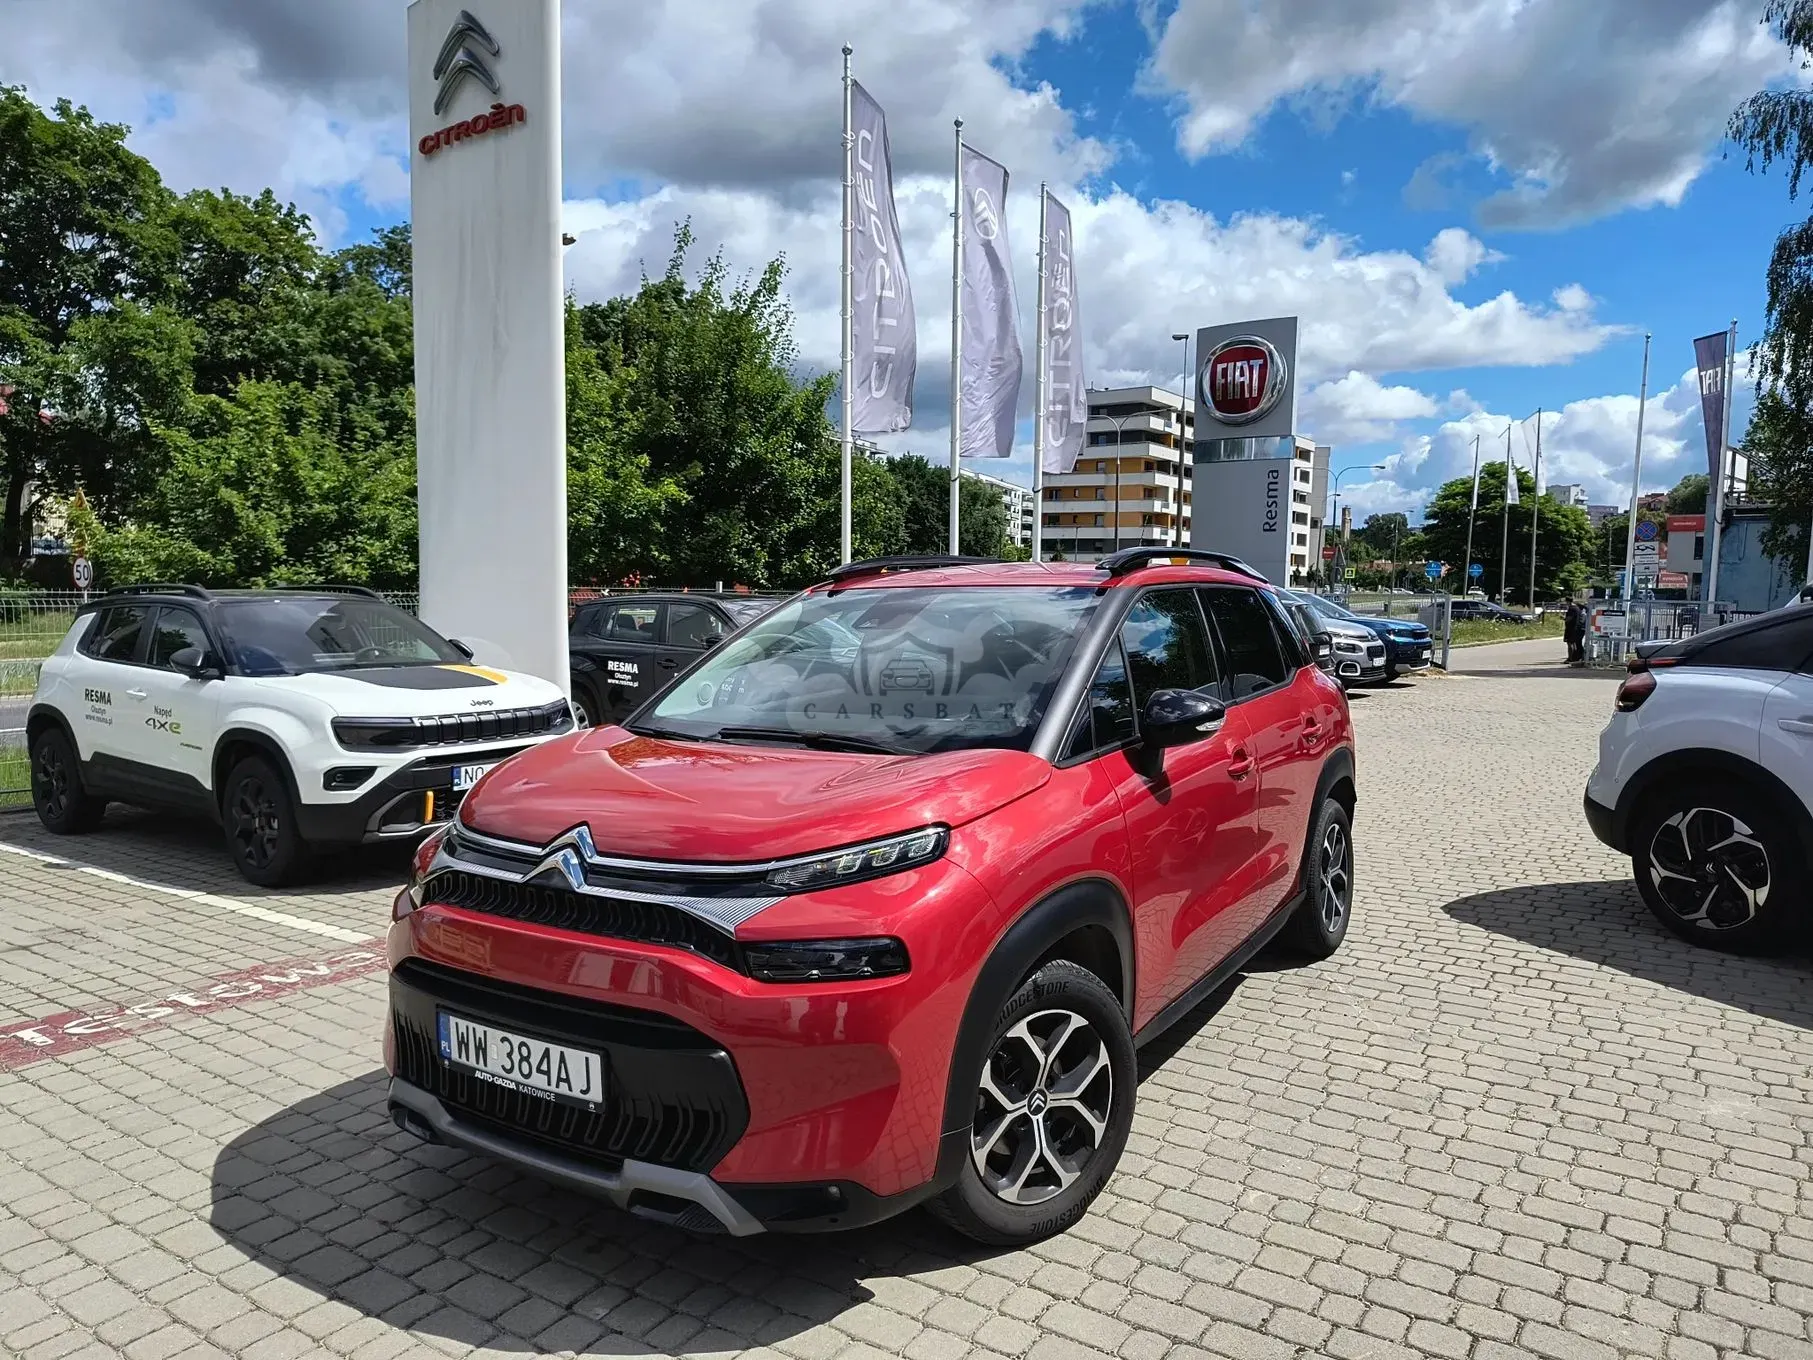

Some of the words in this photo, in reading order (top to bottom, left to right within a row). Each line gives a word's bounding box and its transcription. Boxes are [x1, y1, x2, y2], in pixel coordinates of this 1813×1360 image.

[1215, 359, 1264, 400] FIAT
[1263, 469, 1279, 533] Resma
[75, 564, 89, 581] 50
[607, 660, 639, 674] RESMA
[84, 688, 112, 706] RESMA
[470, 699, 494, 707] Jeep
[441, 1040, 450, 1053] PL
[455, 1021, 488, 1068] WW
[499, 1036, 592, 1096] 384AJ
[518, 1083, 556, 1102] KATOWICE
